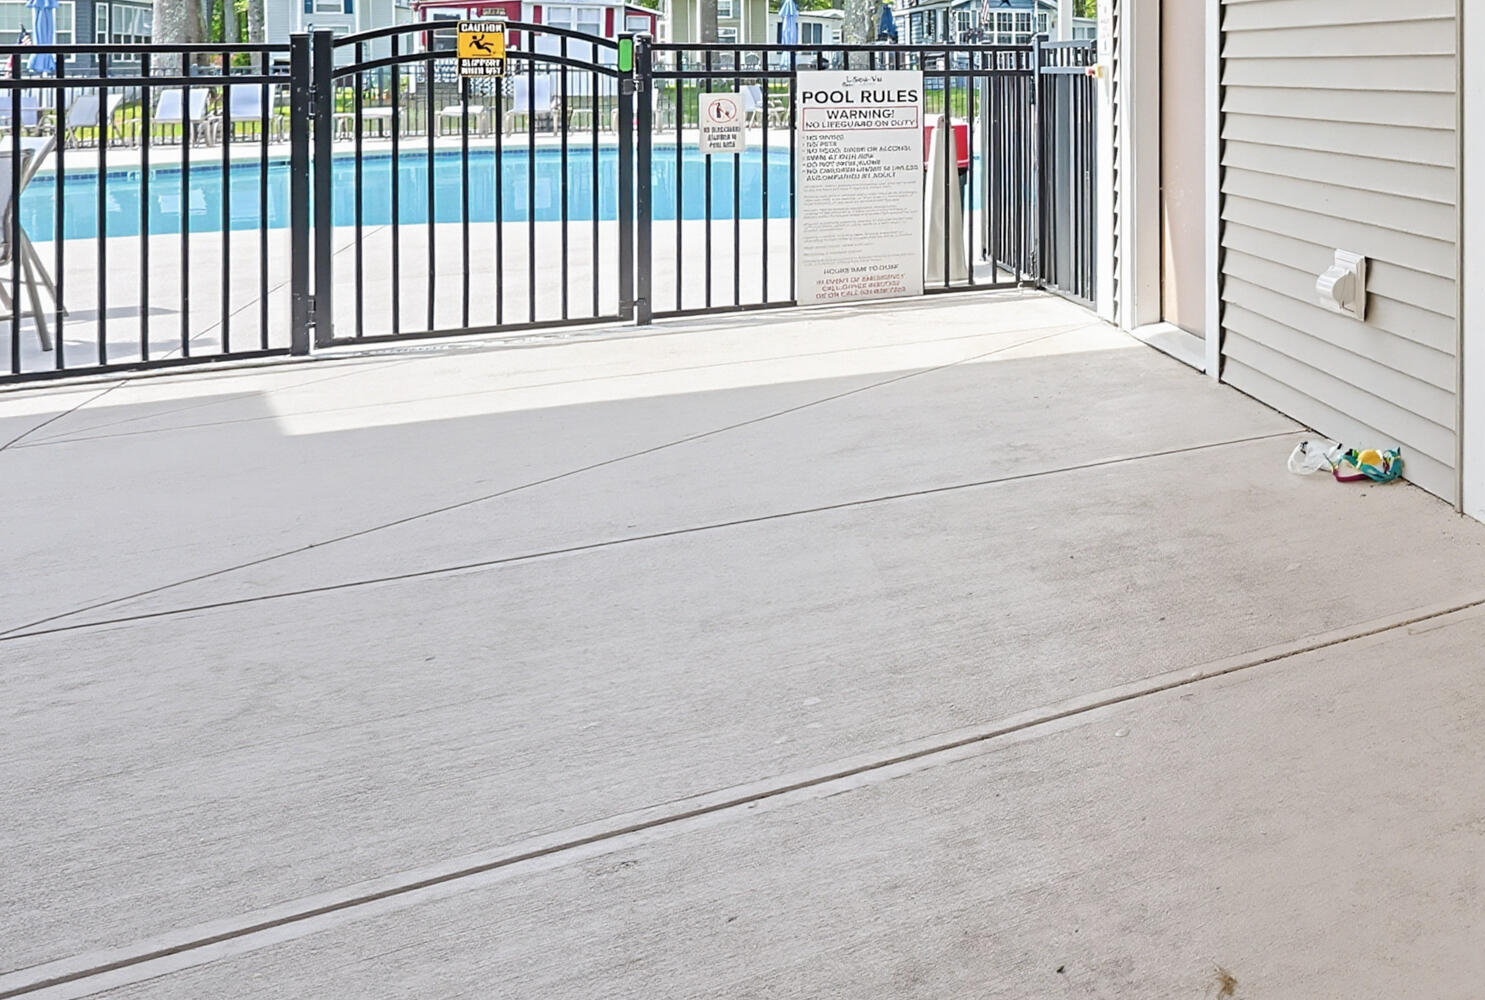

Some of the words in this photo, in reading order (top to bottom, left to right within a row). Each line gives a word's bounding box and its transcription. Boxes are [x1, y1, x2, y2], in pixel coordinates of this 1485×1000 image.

[461, 23, 502, 32] CAUTION
[803, 91, 854, 103] POOL
[861, 90, 918, 103] RULES
[827, 109, 895, 119] WARNING!
[822, 120, 873, 128] LIFEGUARD
